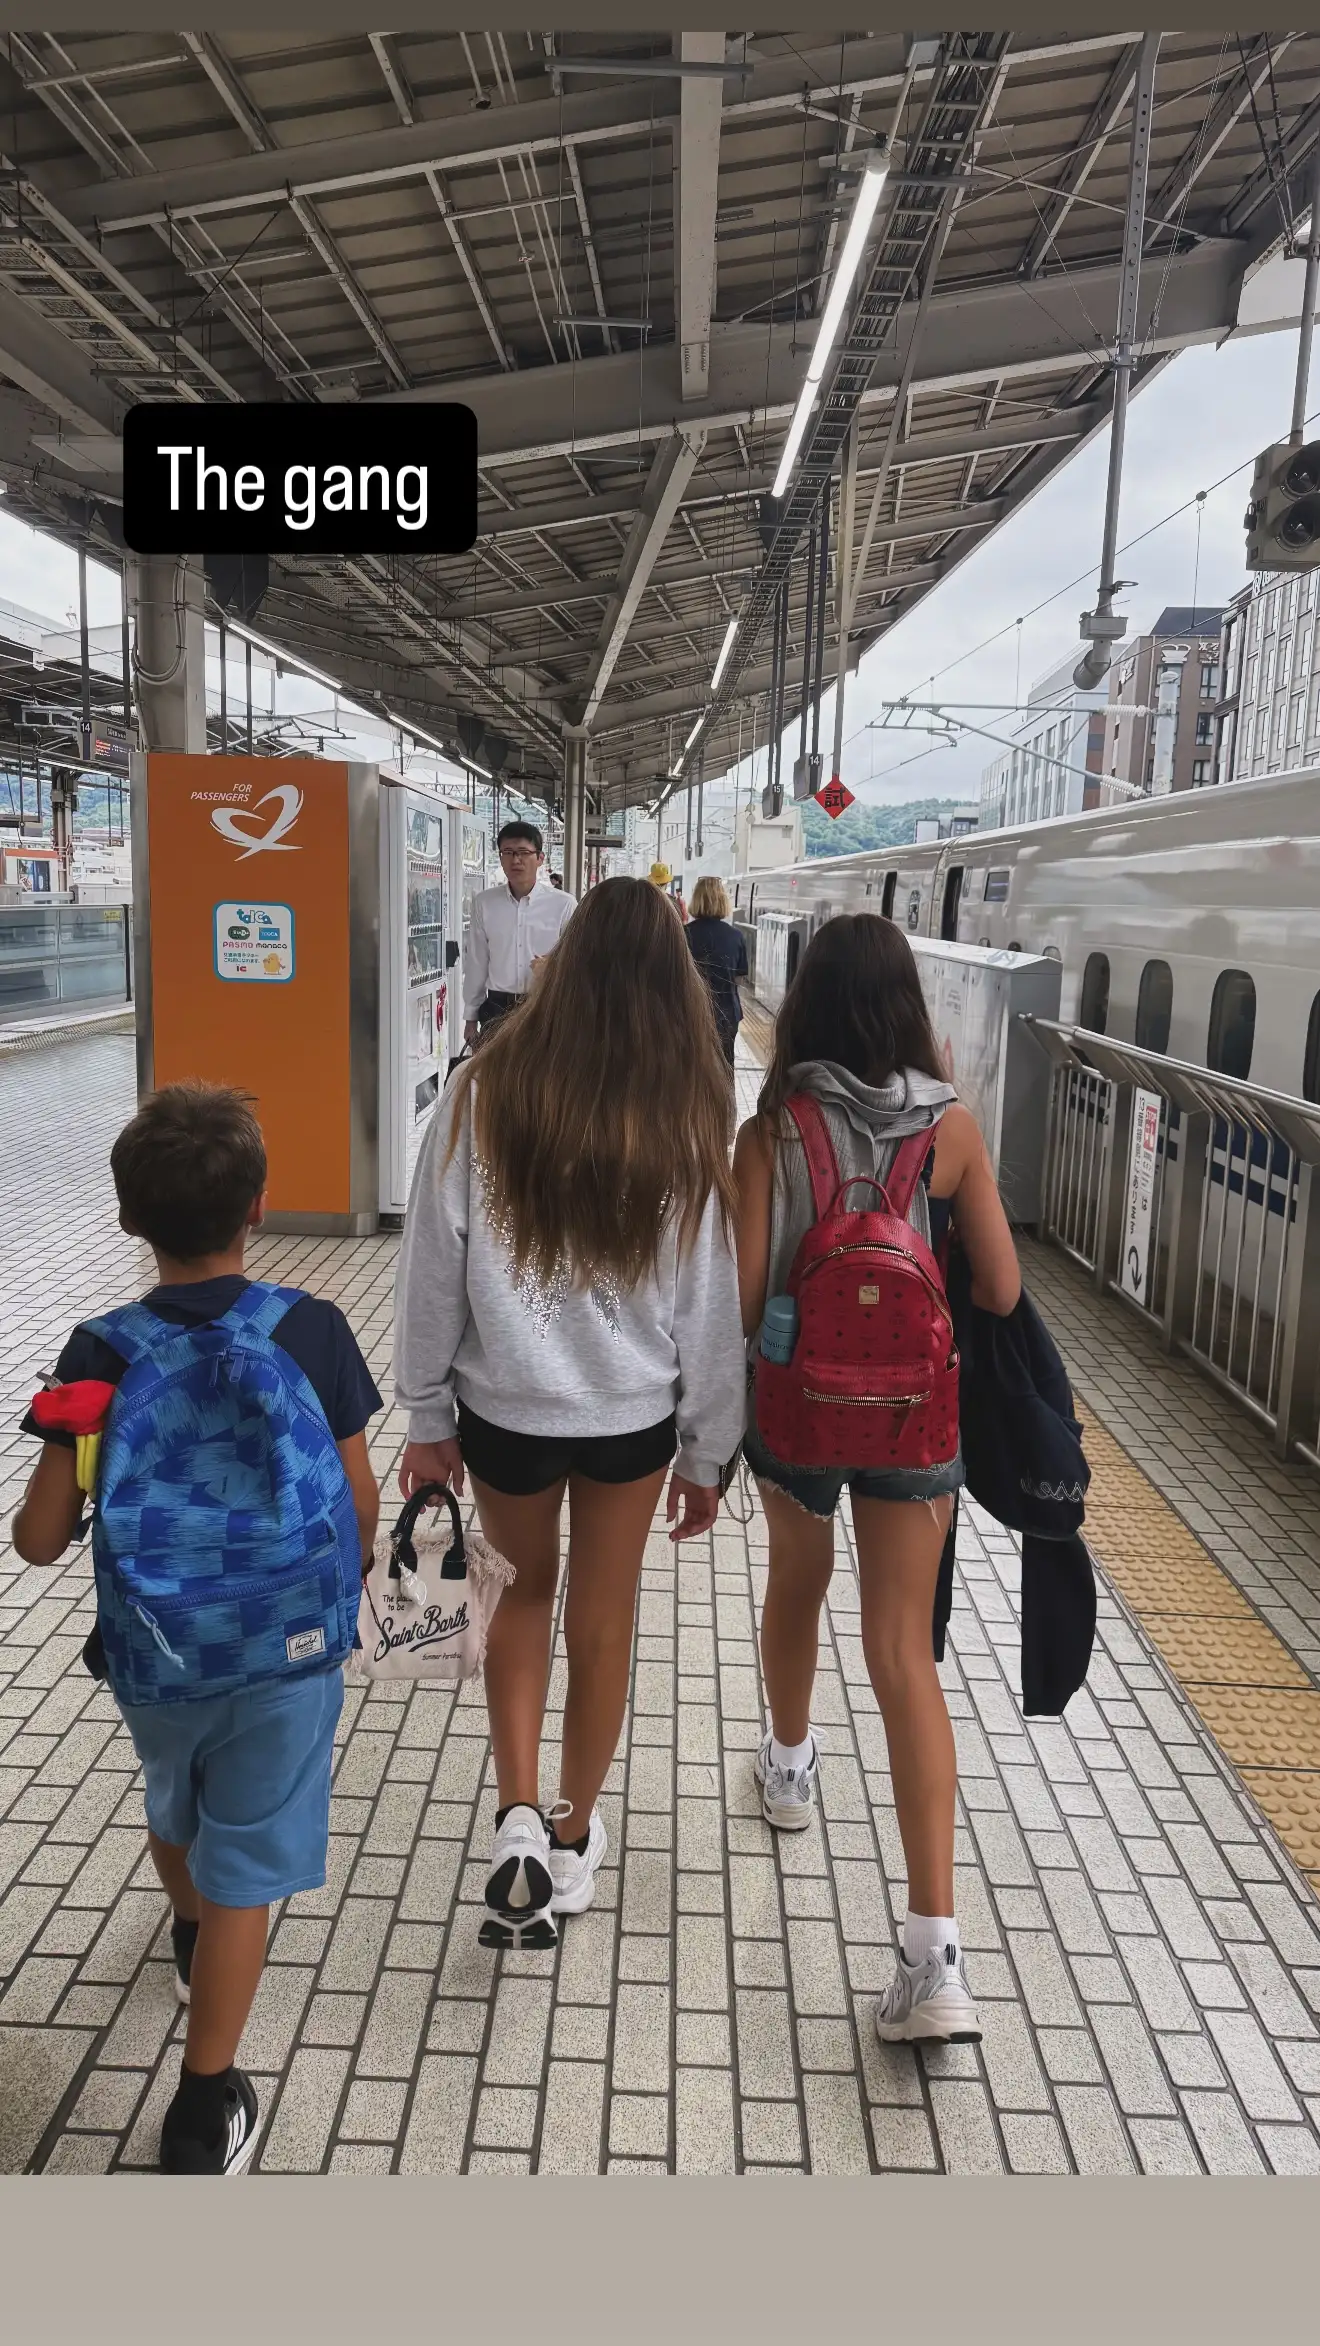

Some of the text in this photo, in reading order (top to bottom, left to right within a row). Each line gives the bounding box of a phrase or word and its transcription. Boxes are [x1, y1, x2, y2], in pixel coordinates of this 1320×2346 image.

[81, 722, 91, 733] 14
[810, 756, 820, 765] 14
[233, 783, 252, 793] FOR
[773, 785, 781, 793] 15
[190, 791, 250, 802] PASSENGERS
[824, 786, 846, 809] 試
[222, 941, 254, 949] PASMO
[382, 1594, 394, 1603] The
[387, 1603, 405, 1611] to be
[373, 1601, 470, 1662] Saint Barth
